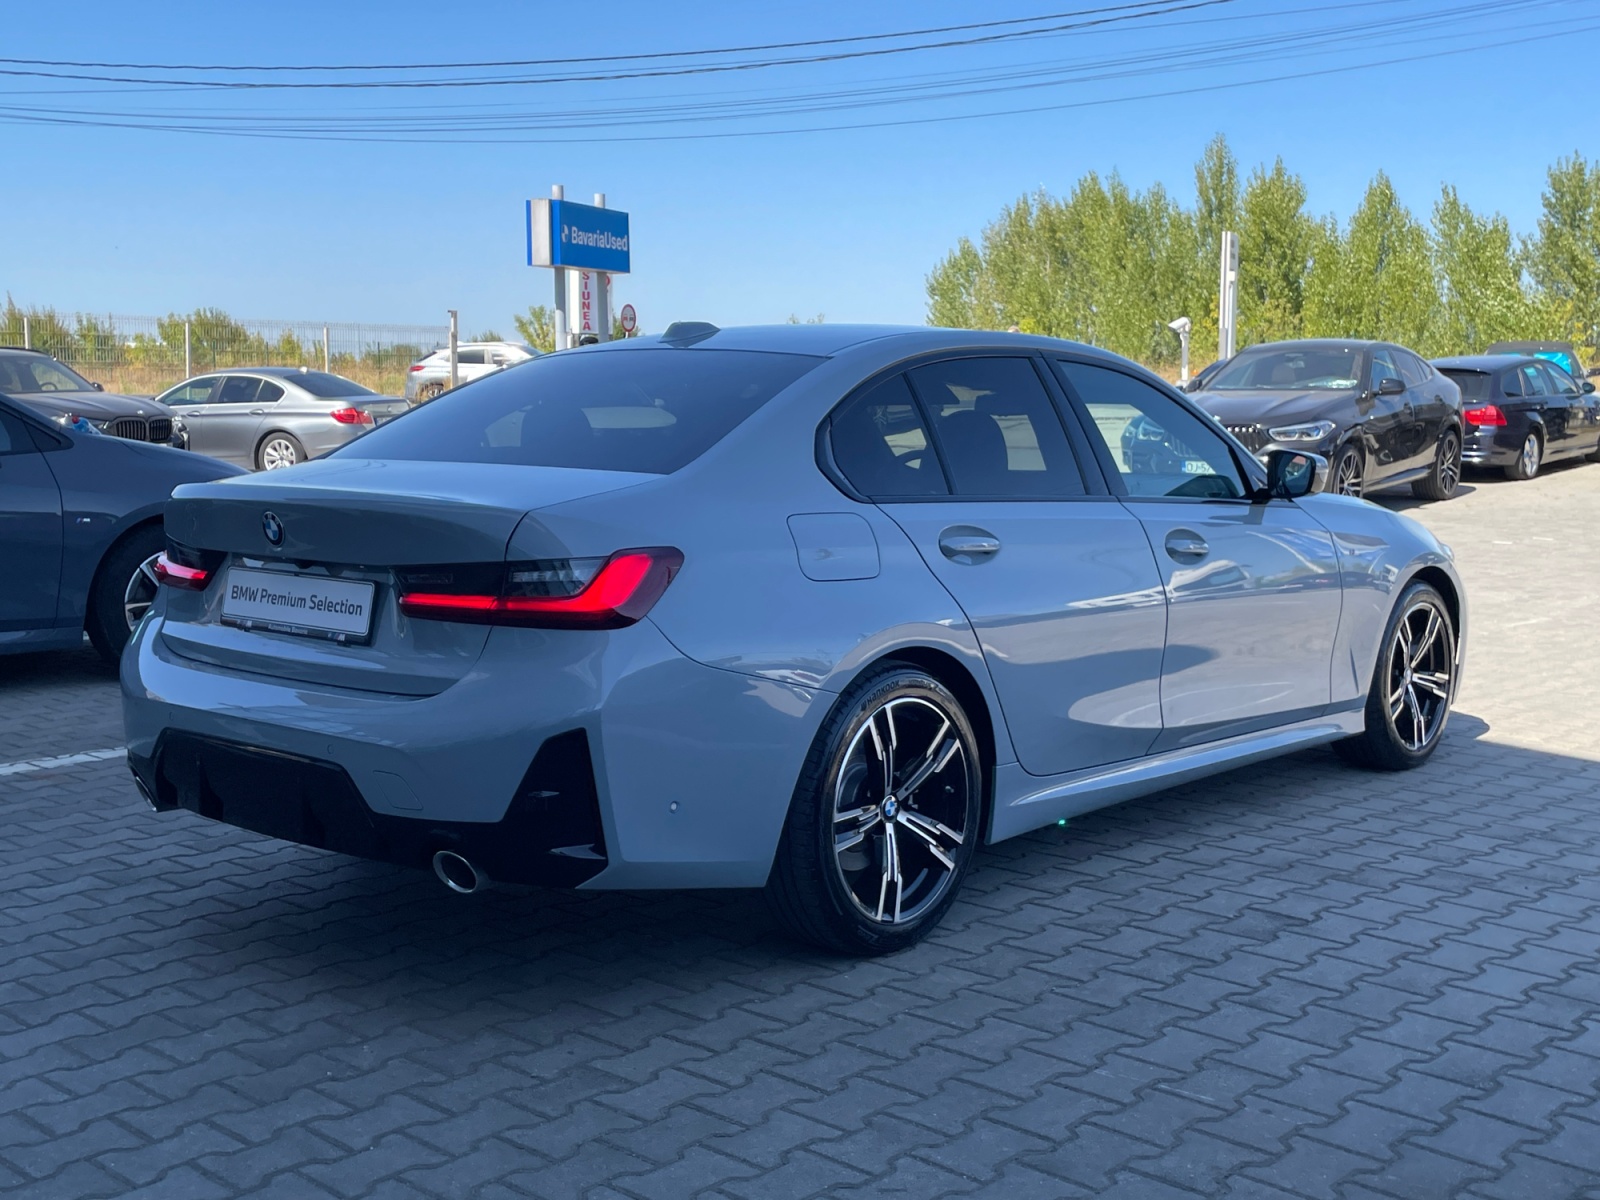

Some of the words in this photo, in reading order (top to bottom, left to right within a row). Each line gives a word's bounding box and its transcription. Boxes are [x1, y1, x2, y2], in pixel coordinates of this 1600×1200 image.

[571, 225, 628, 251] BavariaUsed
[231, 585, 259, 602] BMW
[259, 588, 307, 609] Premium
[308, 594, 363, 616] Selection
